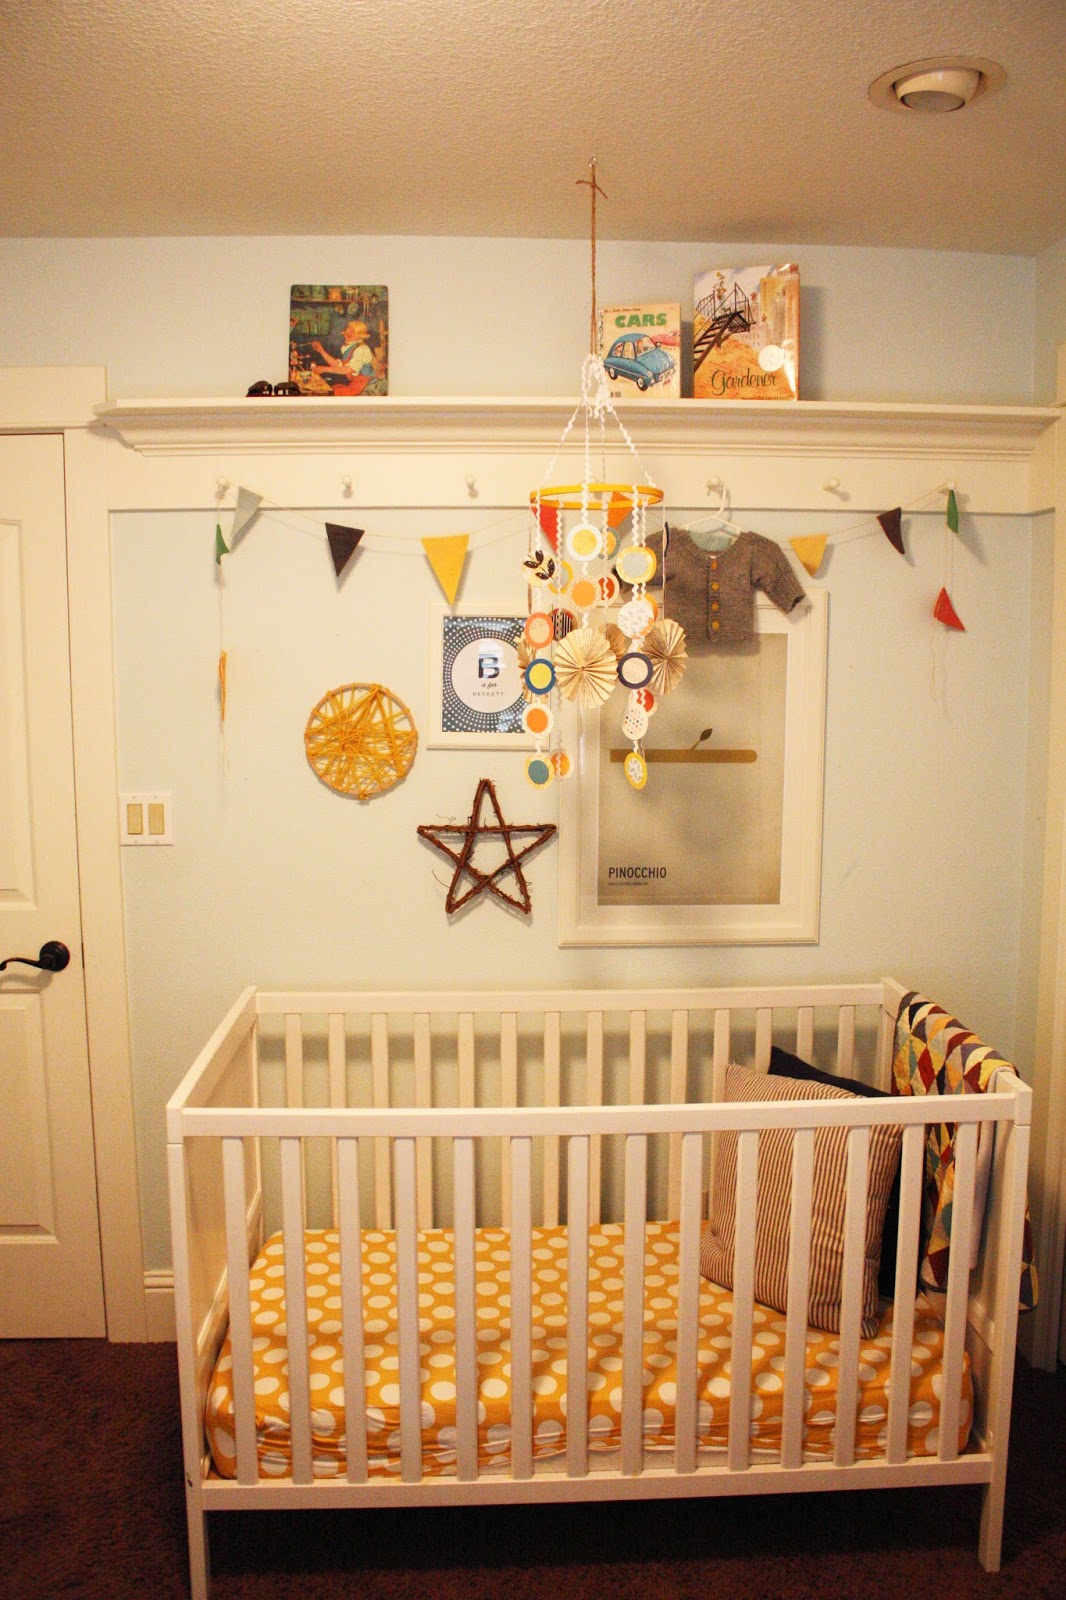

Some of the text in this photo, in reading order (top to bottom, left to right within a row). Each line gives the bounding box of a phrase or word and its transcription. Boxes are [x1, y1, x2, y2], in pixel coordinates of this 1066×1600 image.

[614, 313, 667, 328] CARS
[711, 369, 777, 396] Gardener
[478, 653, 500, 678] B
[608, 867, 667, 879] PINOCCHIO
